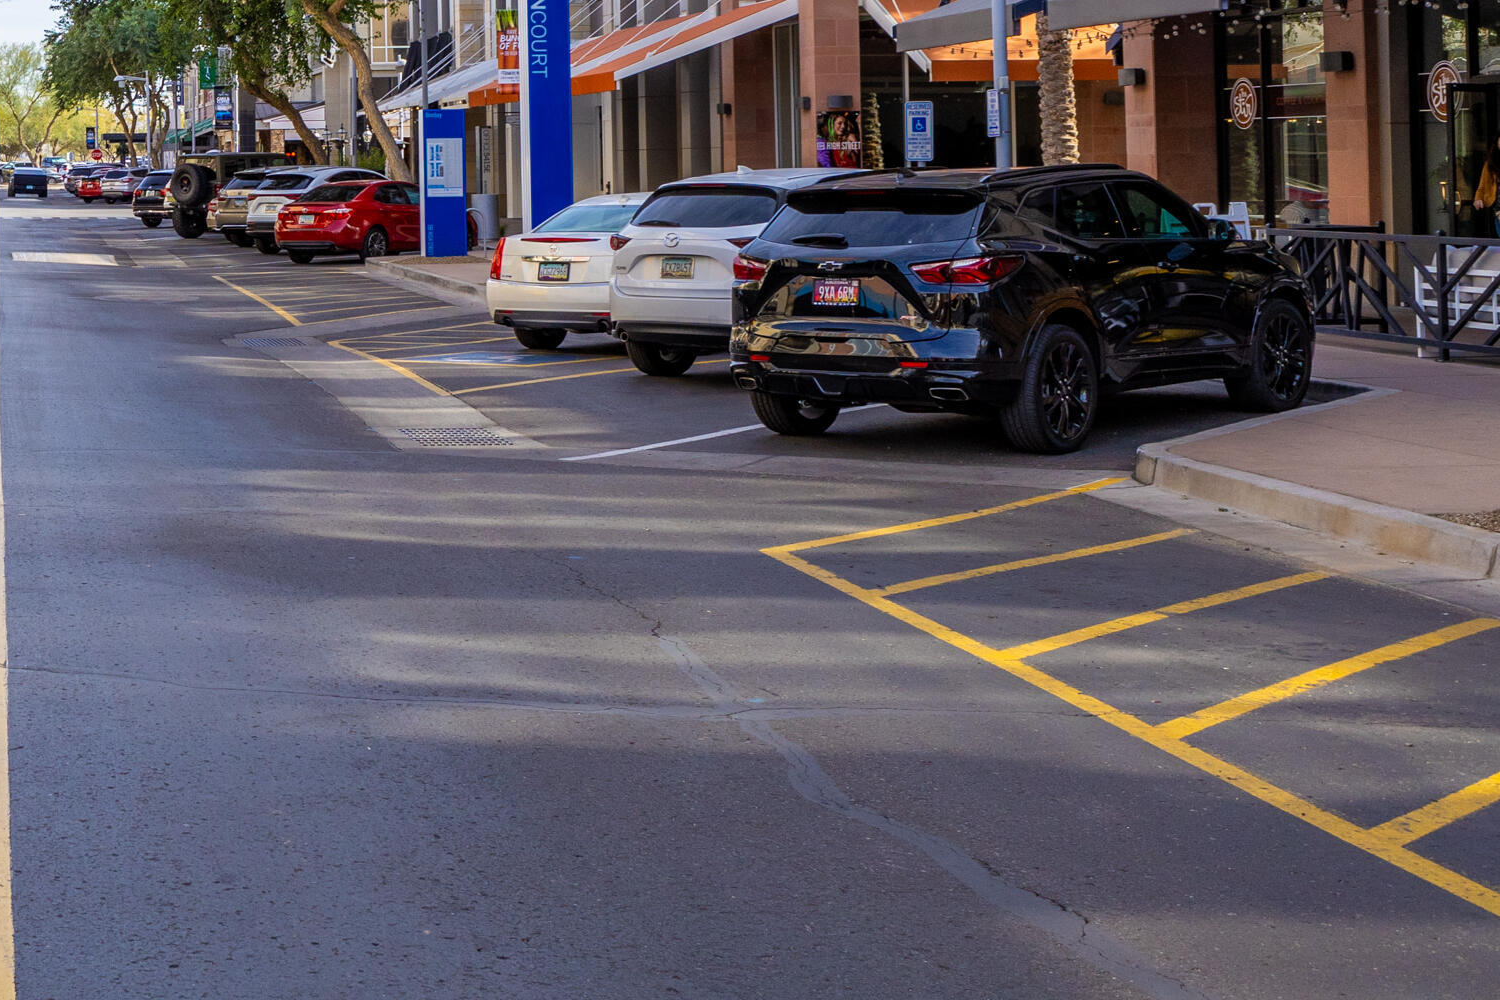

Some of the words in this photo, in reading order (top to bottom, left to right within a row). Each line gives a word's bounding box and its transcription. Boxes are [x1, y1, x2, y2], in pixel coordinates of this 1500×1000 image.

[826, 141, 841, 150] HIGH
[841, 141, 861, 150] STREET
[818, 286, 835, 299] 9XA
